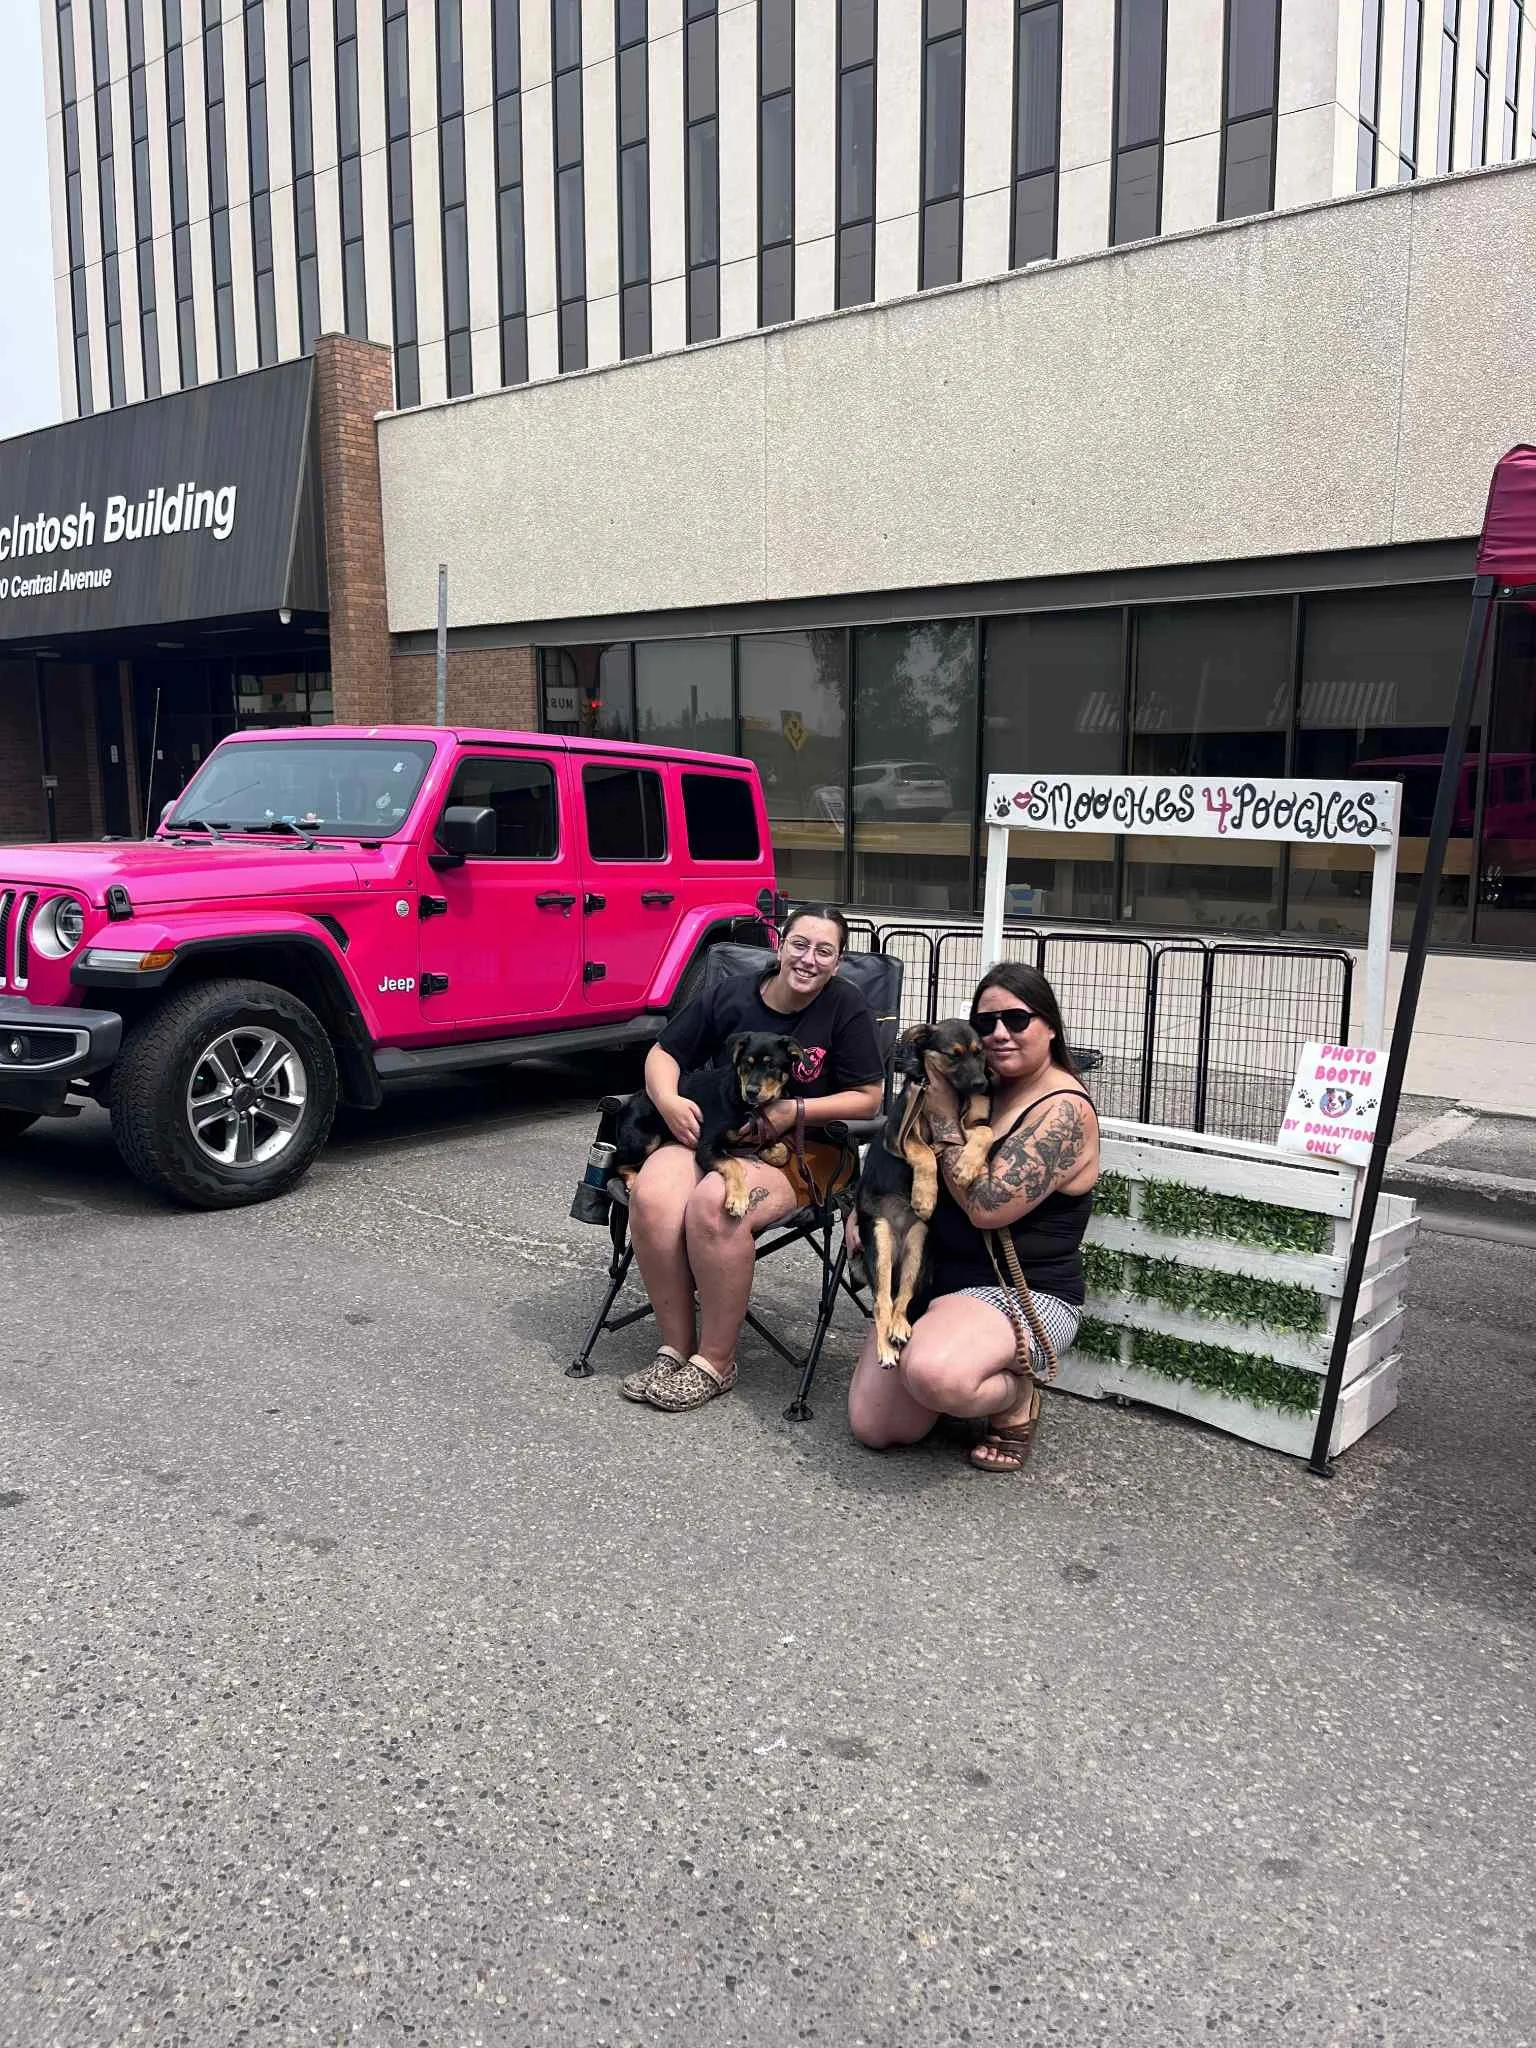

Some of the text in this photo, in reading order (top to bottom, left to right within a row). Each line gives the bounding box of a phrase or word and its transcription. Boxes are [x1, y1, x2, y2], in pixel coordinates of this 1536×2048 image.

[103, 482, 237, 542] Building
[0, 568, 112, 599] 0 Central Avenue
[1202, 787, 1232, 833] 4
[378, 976, 415, 992] Jeep
[1321, 1045, 1376, 1064] PHOTO
[1315, 1065, 1372, 1086] BOOTH
[1284, 1118, 1375, 1143] BY DONATION
[1306, 1139, 1341, 1154] ONLY
